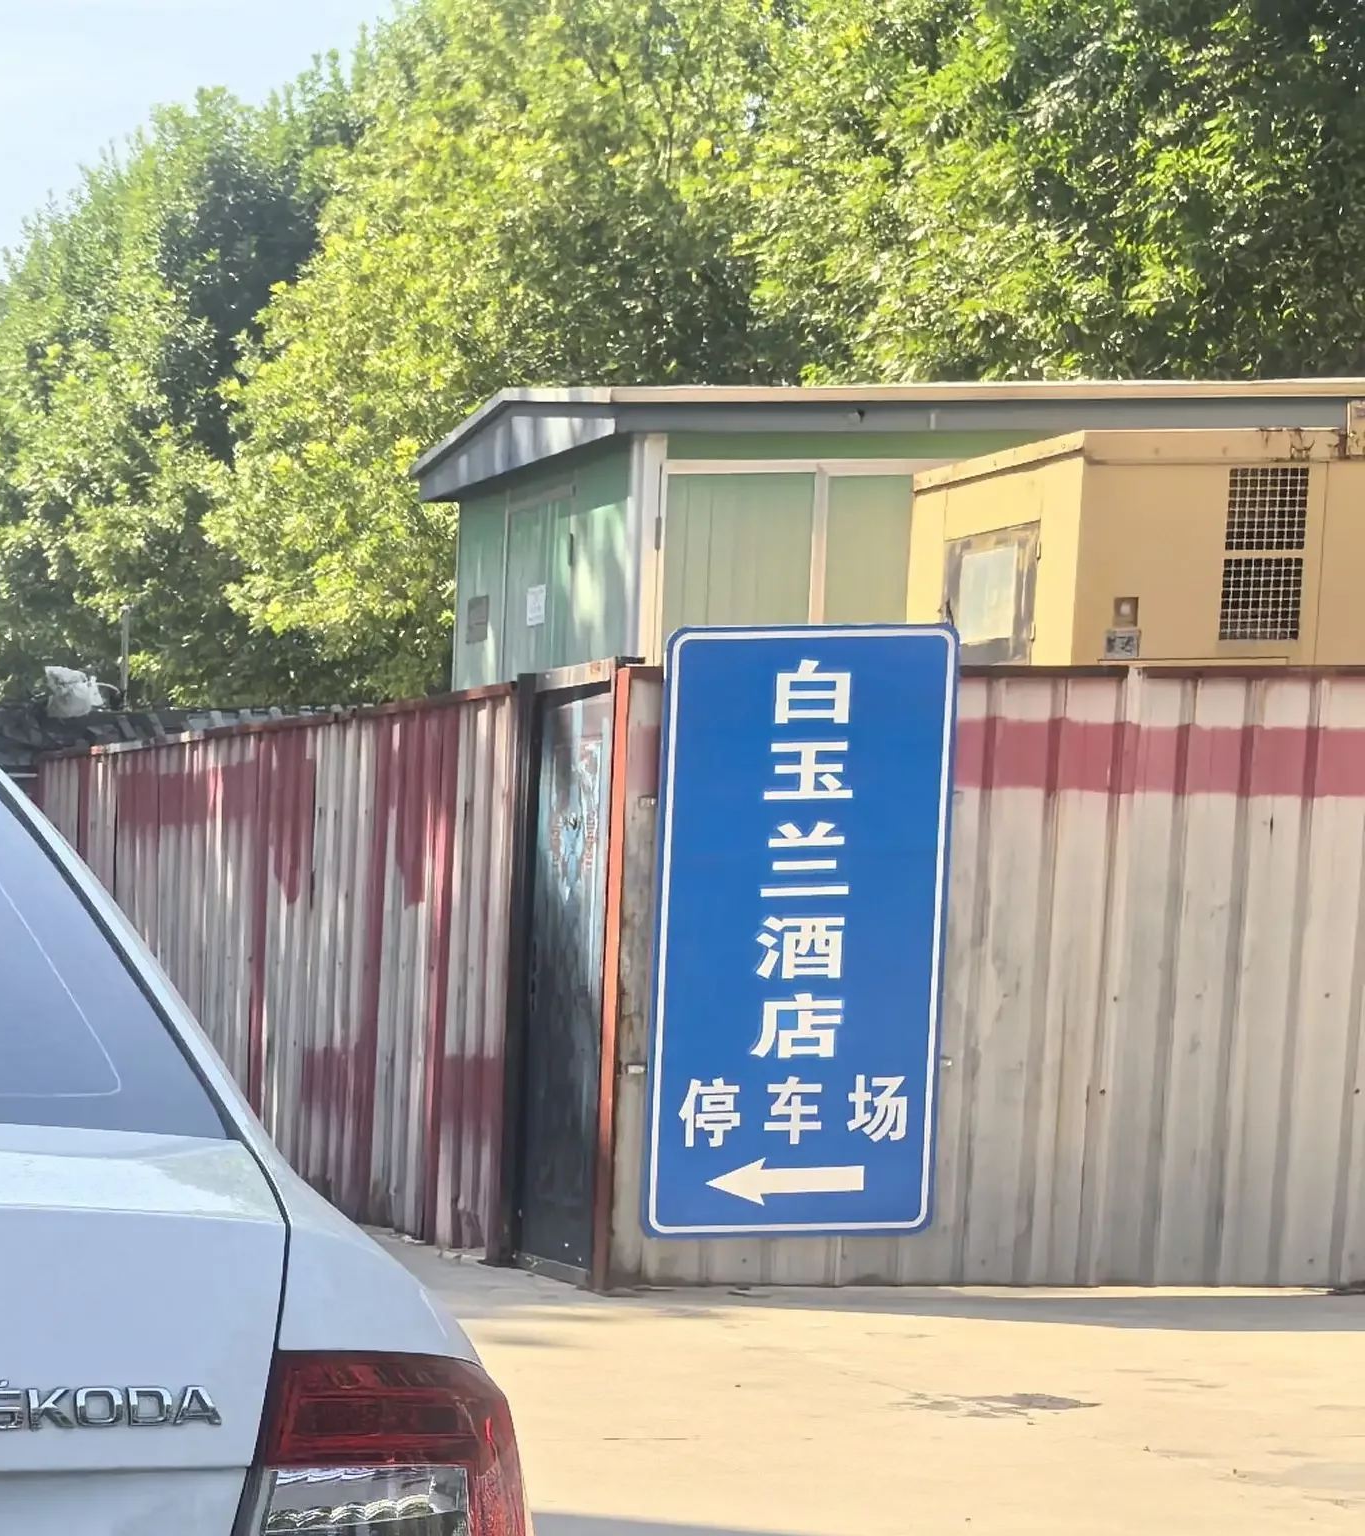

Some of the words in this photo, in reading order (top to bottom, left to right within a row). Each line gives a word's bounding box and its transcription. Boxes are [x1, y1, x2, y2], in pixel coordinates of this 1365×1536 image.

[751, 658, 854, 1059] 白玉兰酒店
[678, 1074, 908, 1148] 停车场
